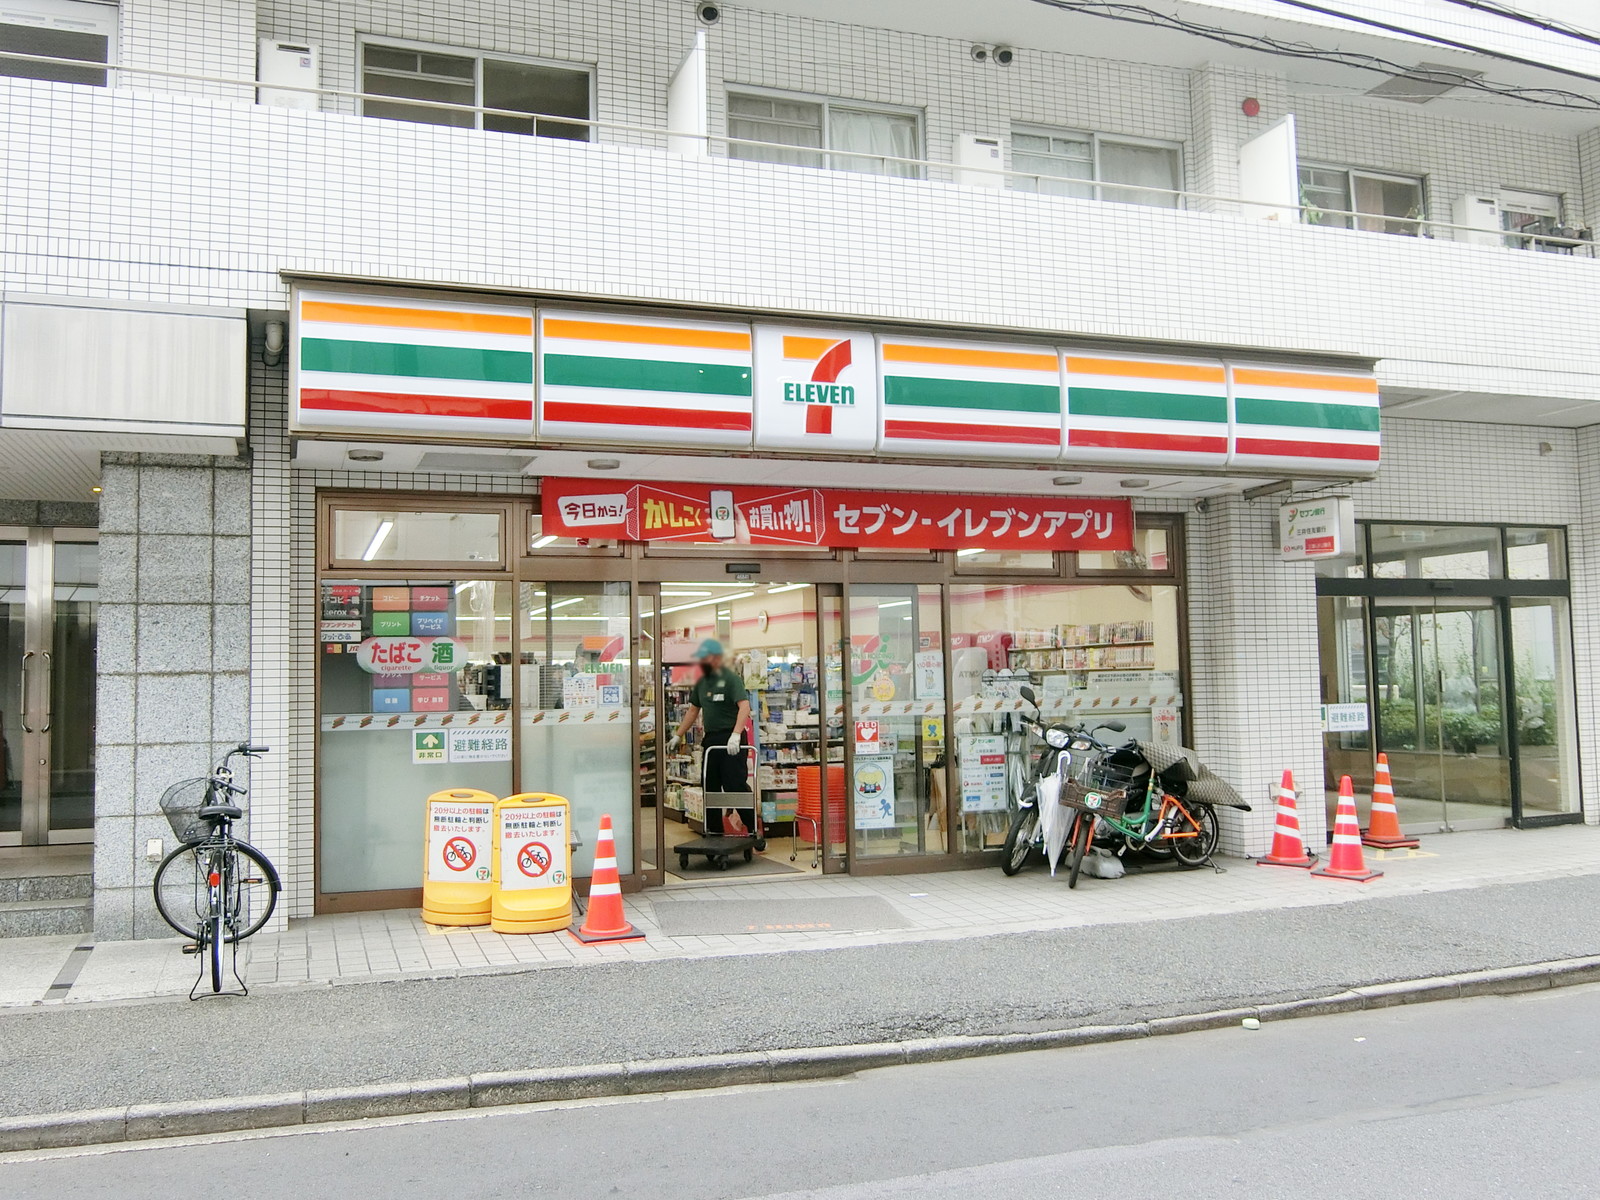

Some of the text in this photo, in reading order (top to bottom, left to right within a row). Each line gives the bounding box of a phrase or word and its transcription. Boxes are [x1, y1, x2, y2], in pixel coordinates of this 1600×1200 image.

[564, 502, 623, 520] 今日から!
[643, 498, 812, 533] かしこく お買い物!
[1299, 507, 1326, 518] セブン銀行
[1297, 526, 1327, 536] 三井住友銀行
[371, 642, 422, 664] たばこ
[432, 642, 454, 664] 酒
[1331, 711, 1365, 722] 避難経路
[454, 738, 508, 752] 避難経路
[434, 807, 489, 815] 20分以上の駐輪は
[505, 812, 562, 821] 20分以上の駐輪は
[434, 816, 489, 824] 無断駐輪と判断し
[505, 821, 562, 830] 無断駐輪と判断し
[505, 830, 559, 839] 撤去いたします。
